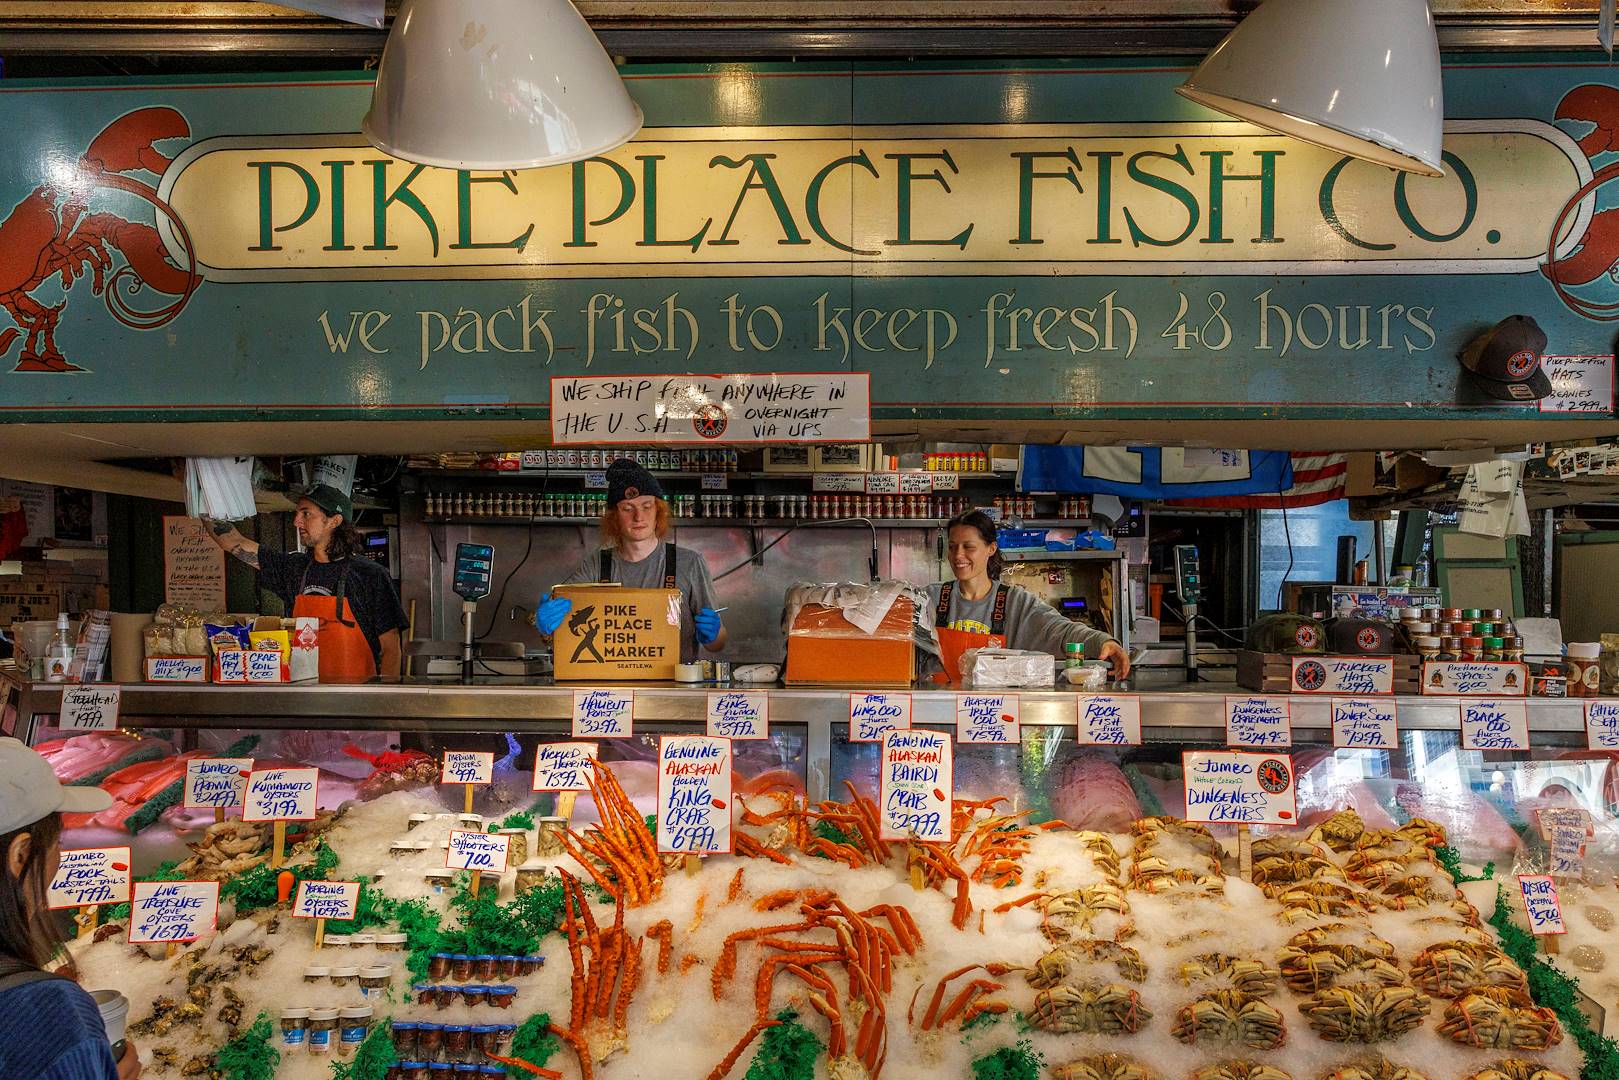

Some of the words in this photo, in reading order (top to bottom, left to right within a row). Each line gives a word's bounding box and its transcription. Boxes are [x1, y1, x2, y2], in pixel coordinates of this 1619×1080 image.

[247, 160, 534, 258] PIKE
[563, 149, 974, 257] PLACE
[1009, 145, 1287, 248] FISH
[1319, 148, 1501, 251] CO.
[318, 304, 392, 353] we
[416, 296, 557, 371] pack
[583, 293, 702, 369] fish
[726, 293, 787, 353] to
[813, 290, 958, 370] keep
[979, 290, 1140, 369] fresh
[1161, 291, 1233, 351] 48
[1254, 288, 1438, 359] hours
[1551, 368, 1586, 381] HATS
[562, 379, 588, 401] WE
[600, 378, 652, 400] SHIP
[721, 381, 816, 404] ANYWHERE
[828, 382, 846, 401] IN
[1550, 389, 1593, 400] BEANIES
[745, 405, 844, 420] OVERNIGHT
[557, 412, 602, 435] THE
[752, 422, 781, 438] VIA
[788, 421, 824, 438] UPS
[604, 605, 637, 618] PIKE
[604, 619, 653, 631] PLACE
[604, 633, 636, 644] FISH
[250, 653, 277, 662] CRAB
[604, 646, 665, 658] MARKET
[1327, 662, 1388, 675] TRUCKER
[1339, 672, 1374, 683] HATS
[1455, 671, 1493, 680] SPICES
[579, 697, 633, 711] HALIBUT
[963, 696, 1005, 707] ALASKAN
[1085, 704, 1121, 719] ROCK
[1464, 709, 1510, 723] BLACK
[973, 715, 1000, 725] COD
[1089, 716, 1121, 726] FISH
[888, 733, 945, 749] GENUINE
[664, 742, 723, 759] GENUINE
[888, 747, 943, 763] ALASKAN
[665, 755, 726, 776] ALASKAN
[1194, 759, 1253, 774] JUMBO
[264, 771, 287, 781] LIVE
[890, 763, 938, 783] BAIRDI
[252, 781, 313, 793] KUMAMOTO
[668, 786, 711, 809] KING
[887, 788, 927, 811] CRAB
[1188, 786, 1268, 806] DUNGENESS
[666, 807, 710, 826] CRAB
[1209, 803, 1266, 821] CRABS
[450, 839, 506, 852] SHOOTERS
[66, 868, 108, 881] ROCK
[155, 885, 183, 898] LIVE
[140, 897, 208, 910] TREASURE
[304, 899, 349, 910] OYSTERS
[157, 908, 181, 916] COVE
[147, 913, 196, 926] OYSTERS
